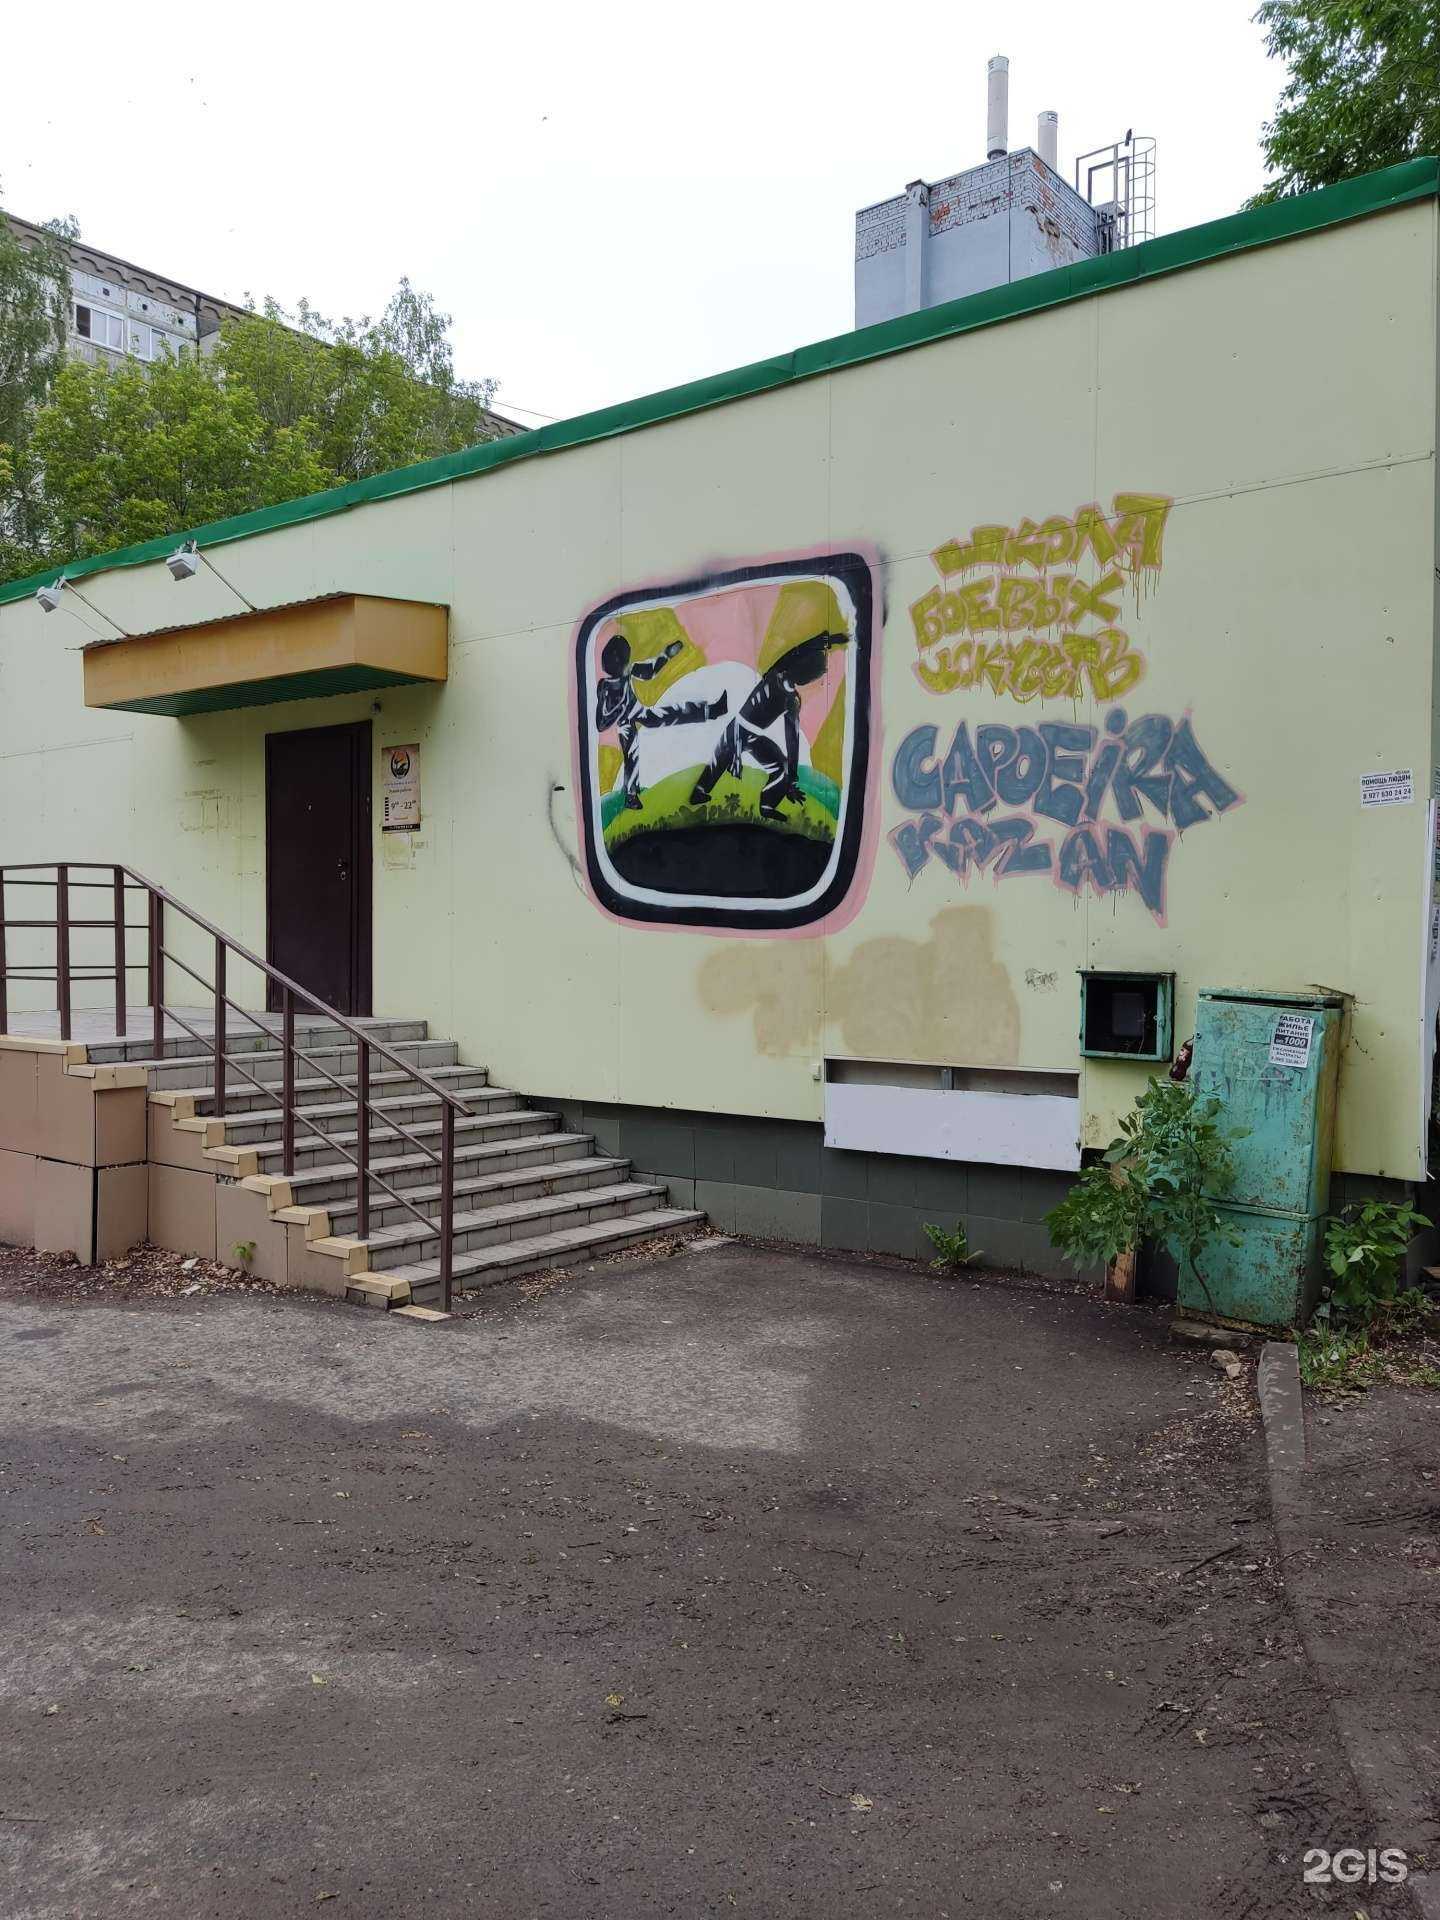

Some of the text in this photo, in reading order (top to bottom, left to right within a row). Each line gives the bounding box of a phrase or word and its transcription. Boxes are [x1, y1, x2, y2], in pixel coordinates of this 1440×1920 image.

[931, 492, 1174, 576] ШКОЛА
[910, 571, 1125, 650] БОЕВЫХ
[1362, 776, 1387, 785] ПОМОЩЬ
[889, 811, 1177, 928] KAZAN
[1279, 1015, 1311, 1024] РАБОТА
[1278, 1022, 1309, 1032] ЖИЛЬЕ
[1275, 1028, 1309, 1038] ПИТАНИЕ
[1284, 1036, 1306, 1047] 1000
